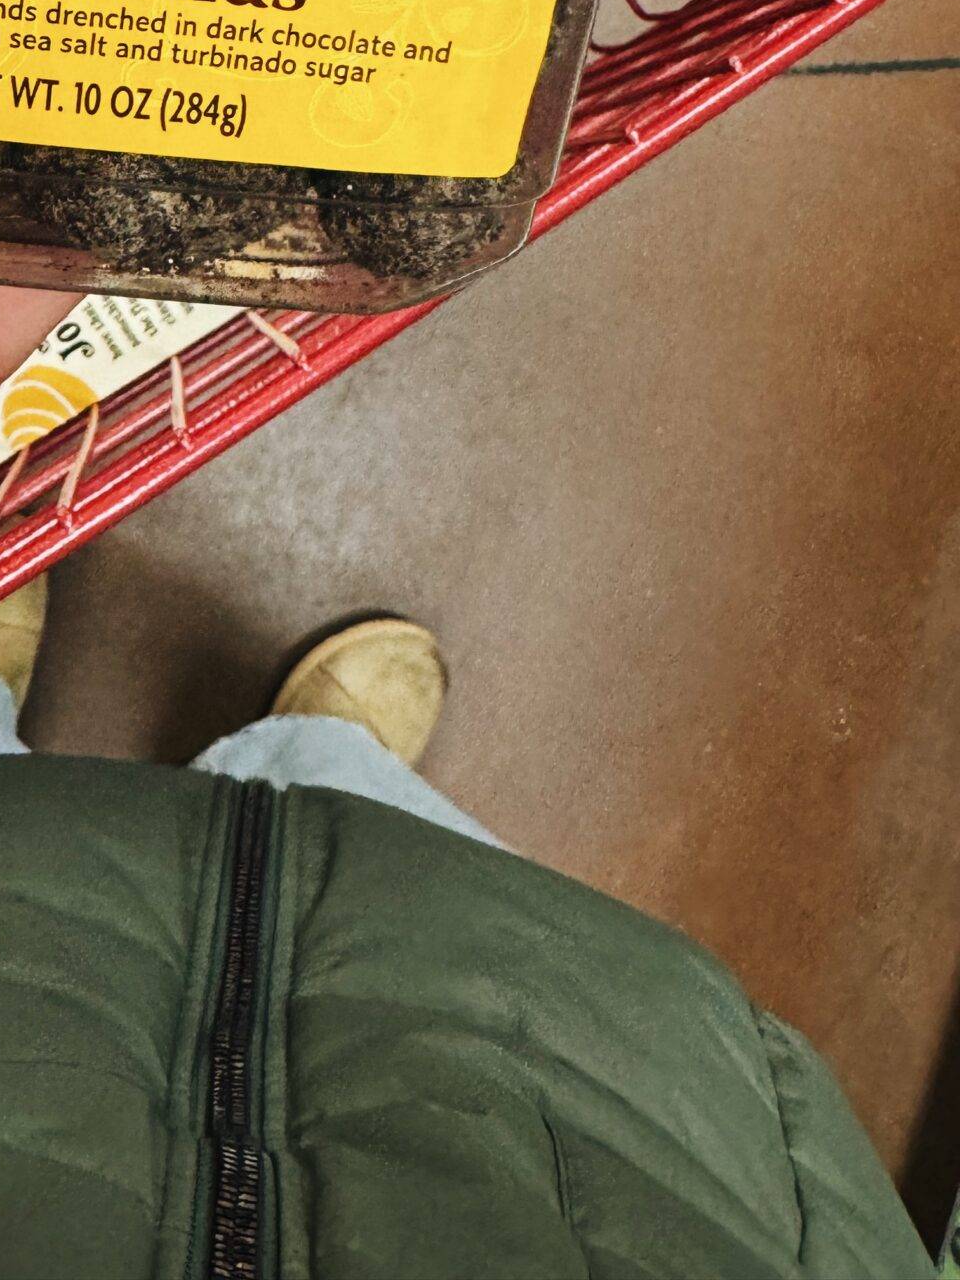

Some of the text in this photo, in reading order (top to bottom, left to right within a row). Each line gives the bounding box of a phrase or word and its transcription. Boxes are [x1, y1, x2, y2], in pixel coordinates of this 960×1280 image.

[9, 32, 52, 52] sea
[60, 32, 108, 57] salt
[115, 38, 164, 62] and
[171, 43, 297, 75] turbinado
[304, 61, 377, 86] sugar
[45, 1, 167, 34] drenched
[175, 12, 197, 37] in
[206, 16, 264, 44] dark
[271, 22, 396, 57] chocolate
[403, 41, 453, 64] and
[10, 75, 64, 112] WT.
[74, 81, 102, 116] 10
[110, 85, 153, 120] OZ
[160, 87, 247, 139] (284g)
